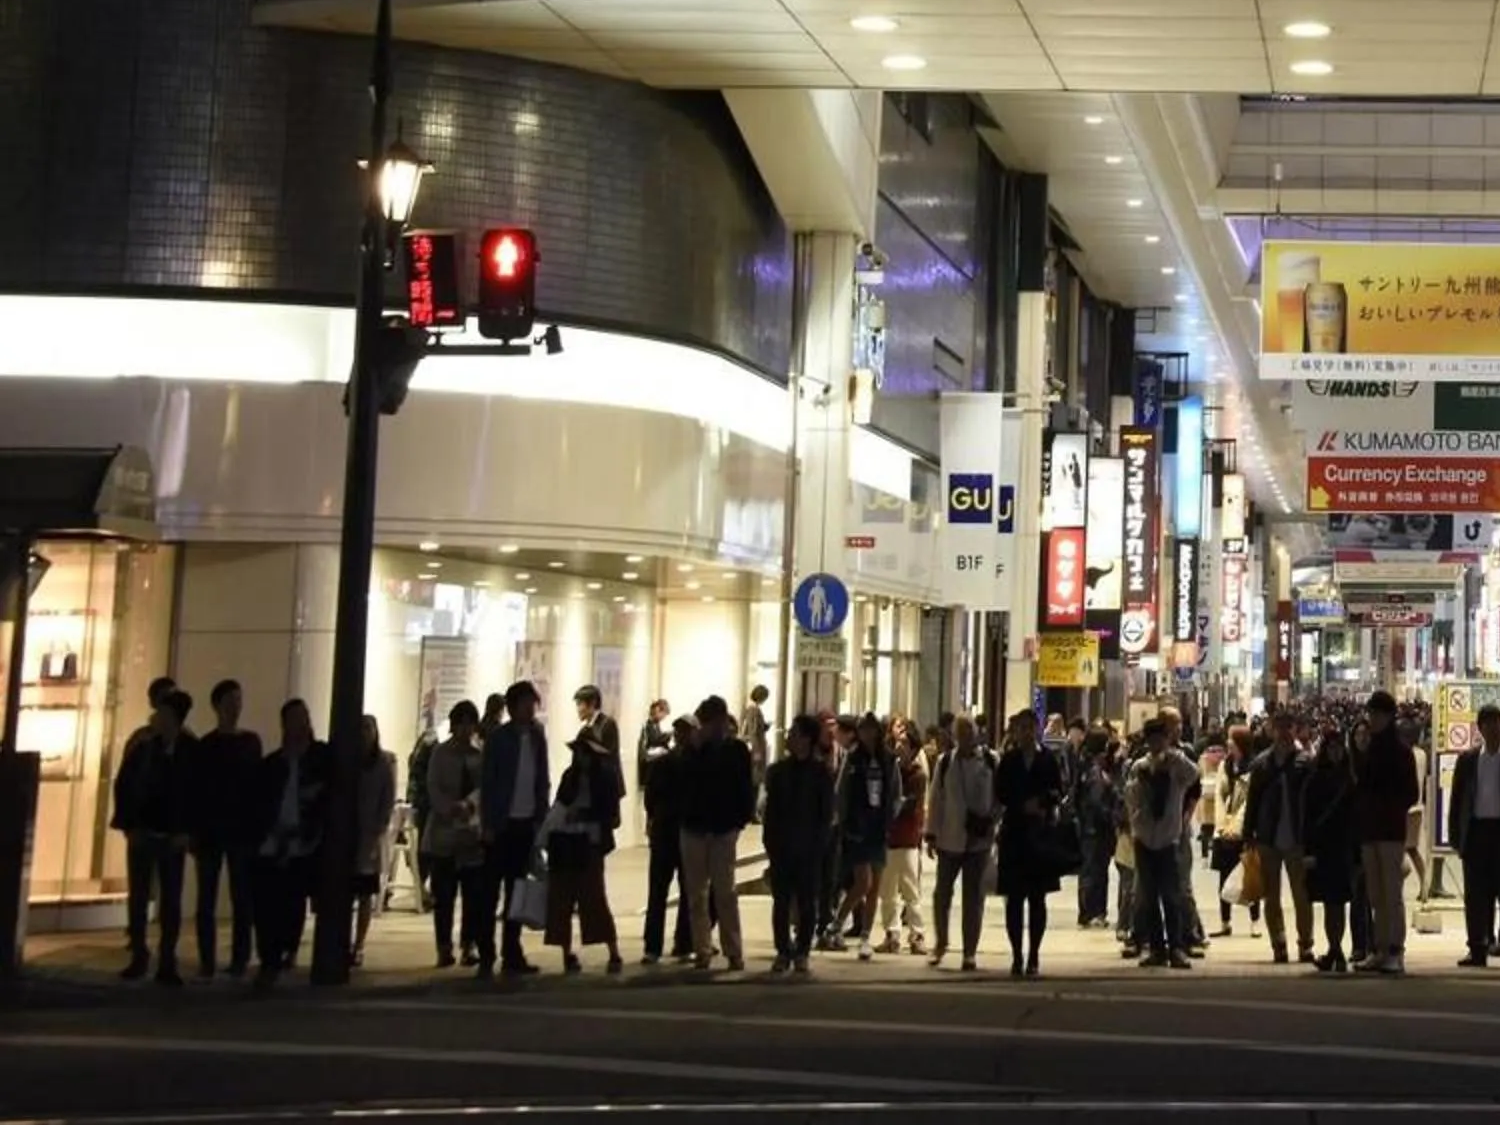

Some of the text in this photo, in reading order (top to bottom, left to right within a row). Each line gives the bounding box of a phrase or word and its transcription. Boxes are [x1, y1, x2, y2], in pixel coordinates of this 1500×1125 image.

[1330, 380, 1392, 398] HANDS
[1344, 432, 1461, 452] KUMAMOTO
[1324, 464, 1487, 487] Currency Exchange
[951, 487, 991, 510] GU
[957, 555, 984, 570] B1F
